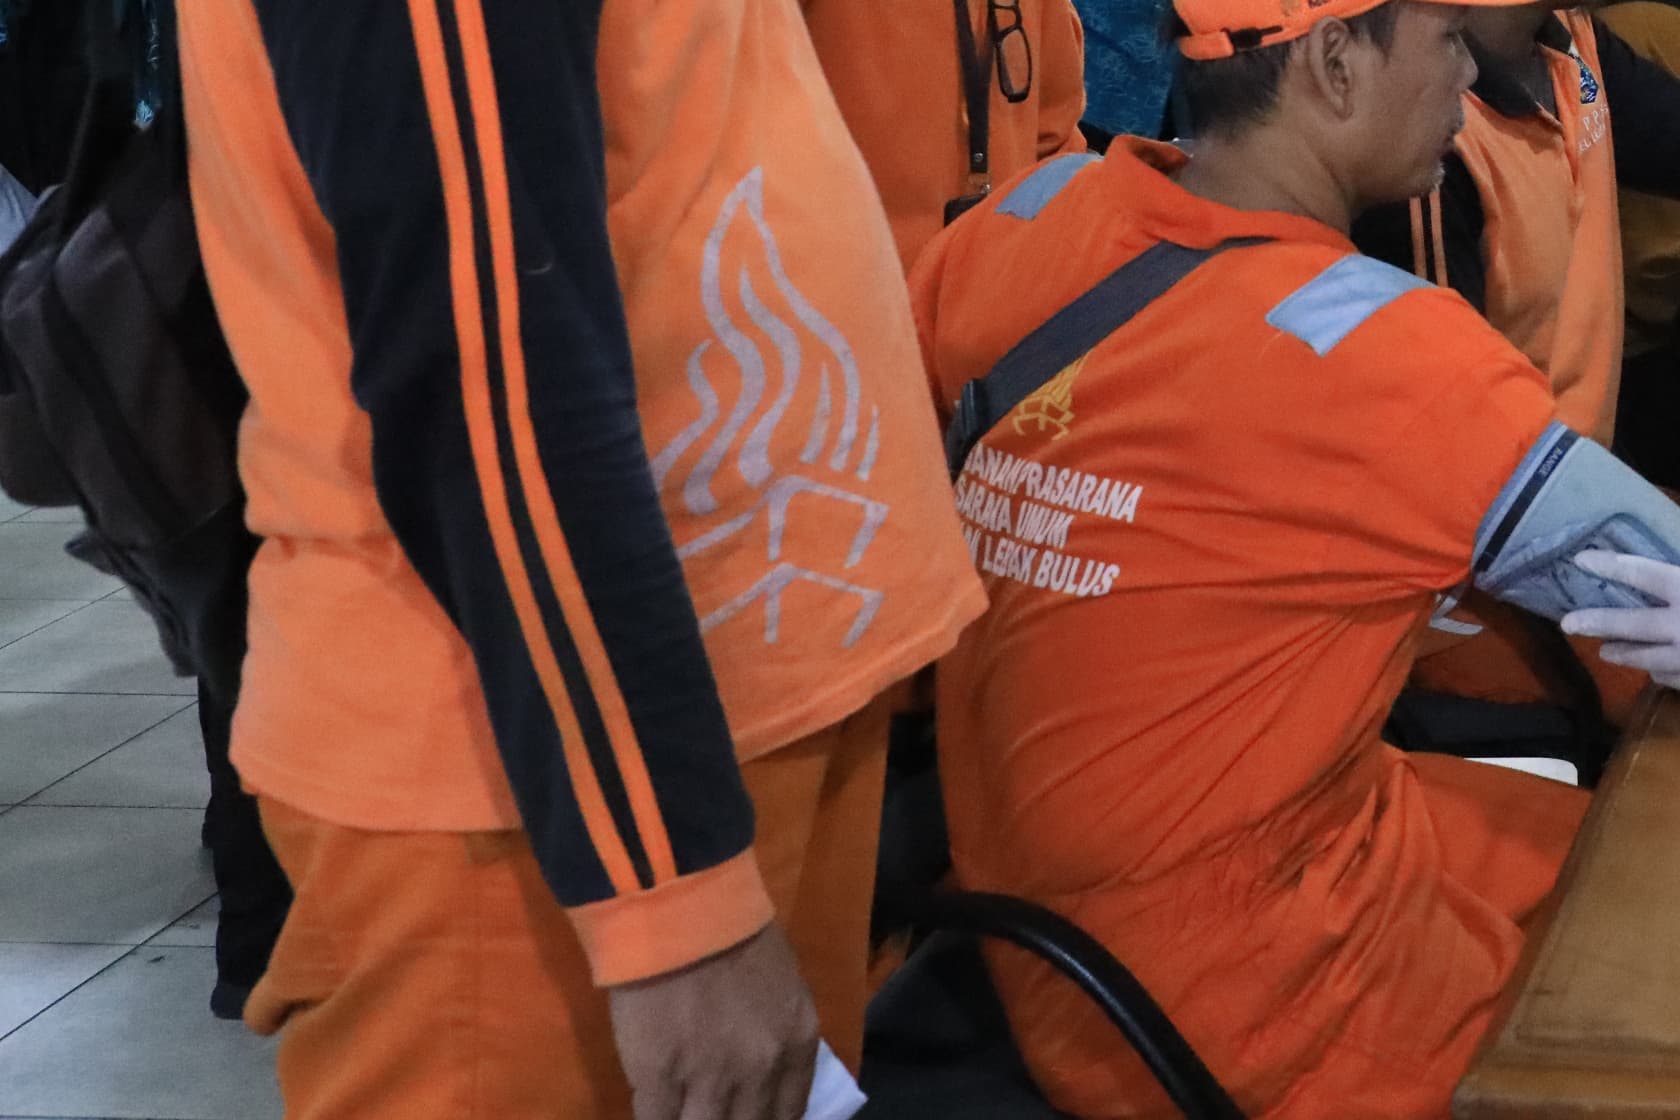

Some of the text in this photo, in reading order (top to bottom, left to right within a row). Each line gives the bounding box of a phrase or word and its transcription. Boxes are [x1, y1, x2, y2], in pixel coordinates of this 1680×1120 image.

[1540, 446, 1563, 478] RANGE
[1014, 500, 1076, 549] UMUM
[1033, 550, 1120, 597] BULUS
